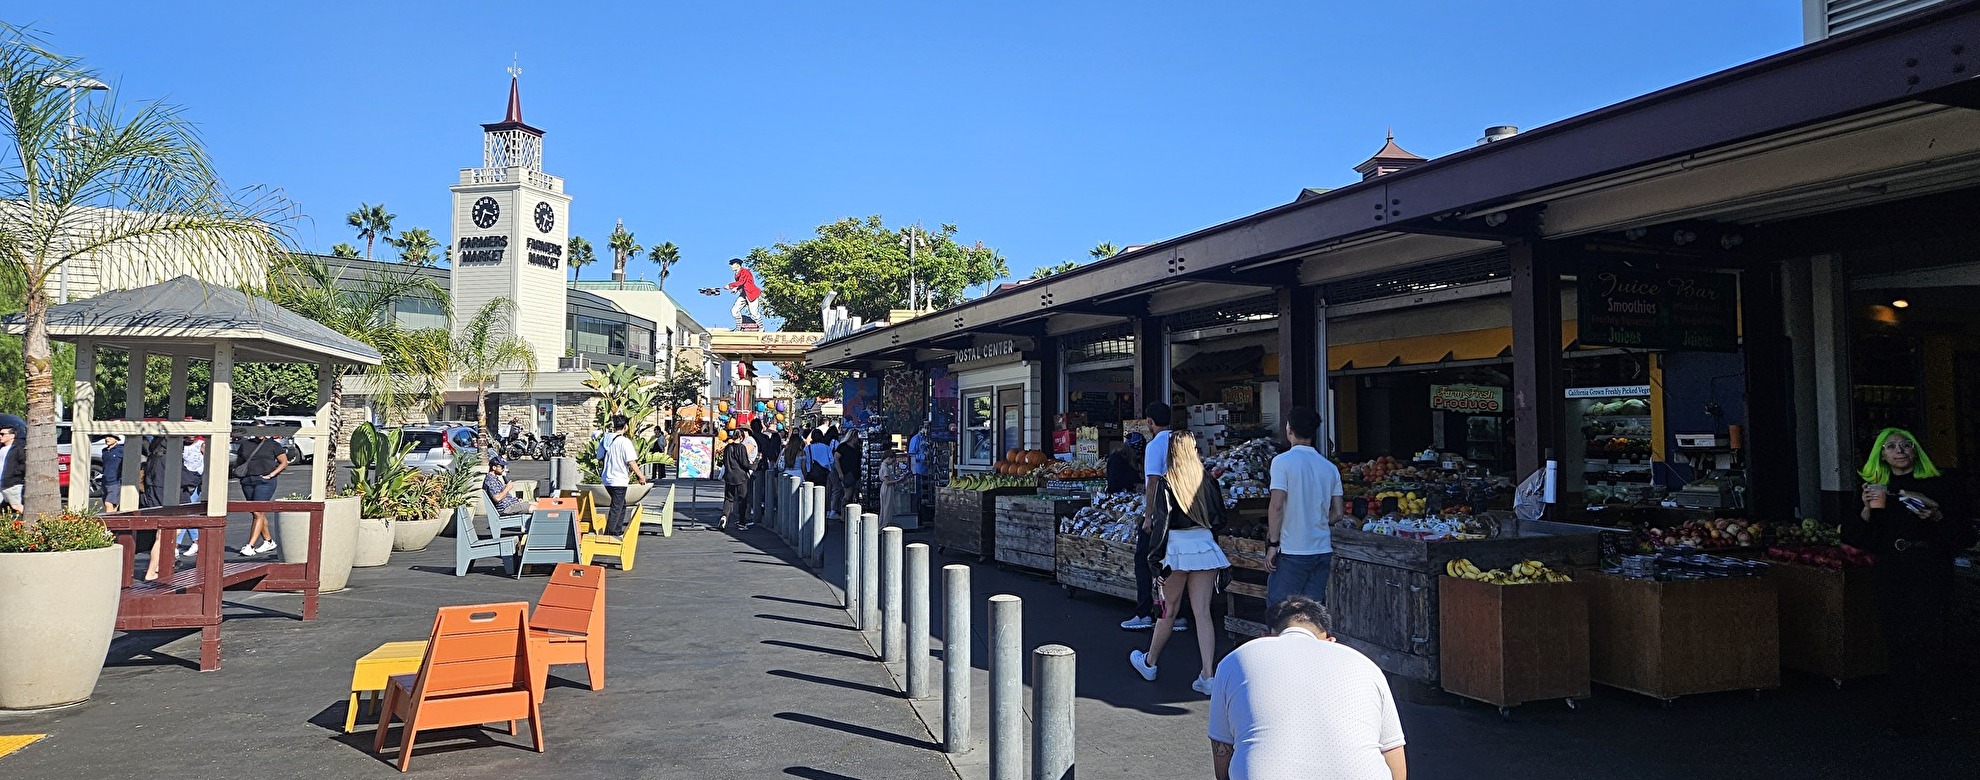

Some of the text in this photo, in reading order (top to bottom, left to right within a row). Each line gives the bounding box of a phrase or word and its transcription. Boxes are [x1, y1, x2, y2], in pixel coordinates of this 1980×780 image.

[460, 235, 508, 249] FARMERS
[526, 237, 562, 257] FARMERS
[462, 249, 505, 263] MARKET
[528, 252, 560, 269] MARKET
[1598, 272, 1721, 300] Juice Bar
[1607, 297, 1656, 314] Smoothies
[761, 334, 821, 344] GILMO
[1607, 326, 1642, 345] Juices
[1682, 330, 1714, 347] Juices
[955, 339, 1013, 363] POSTAL CENTER
[1436, 386, 1494, 399] Farm Fresh
[1568, 389, 1589, 397] California
[1589, 388, 1604, 396] Grown
[1605, 387, 1621, 396] Freshly
[1433, 396, 1499, 410] Produce
